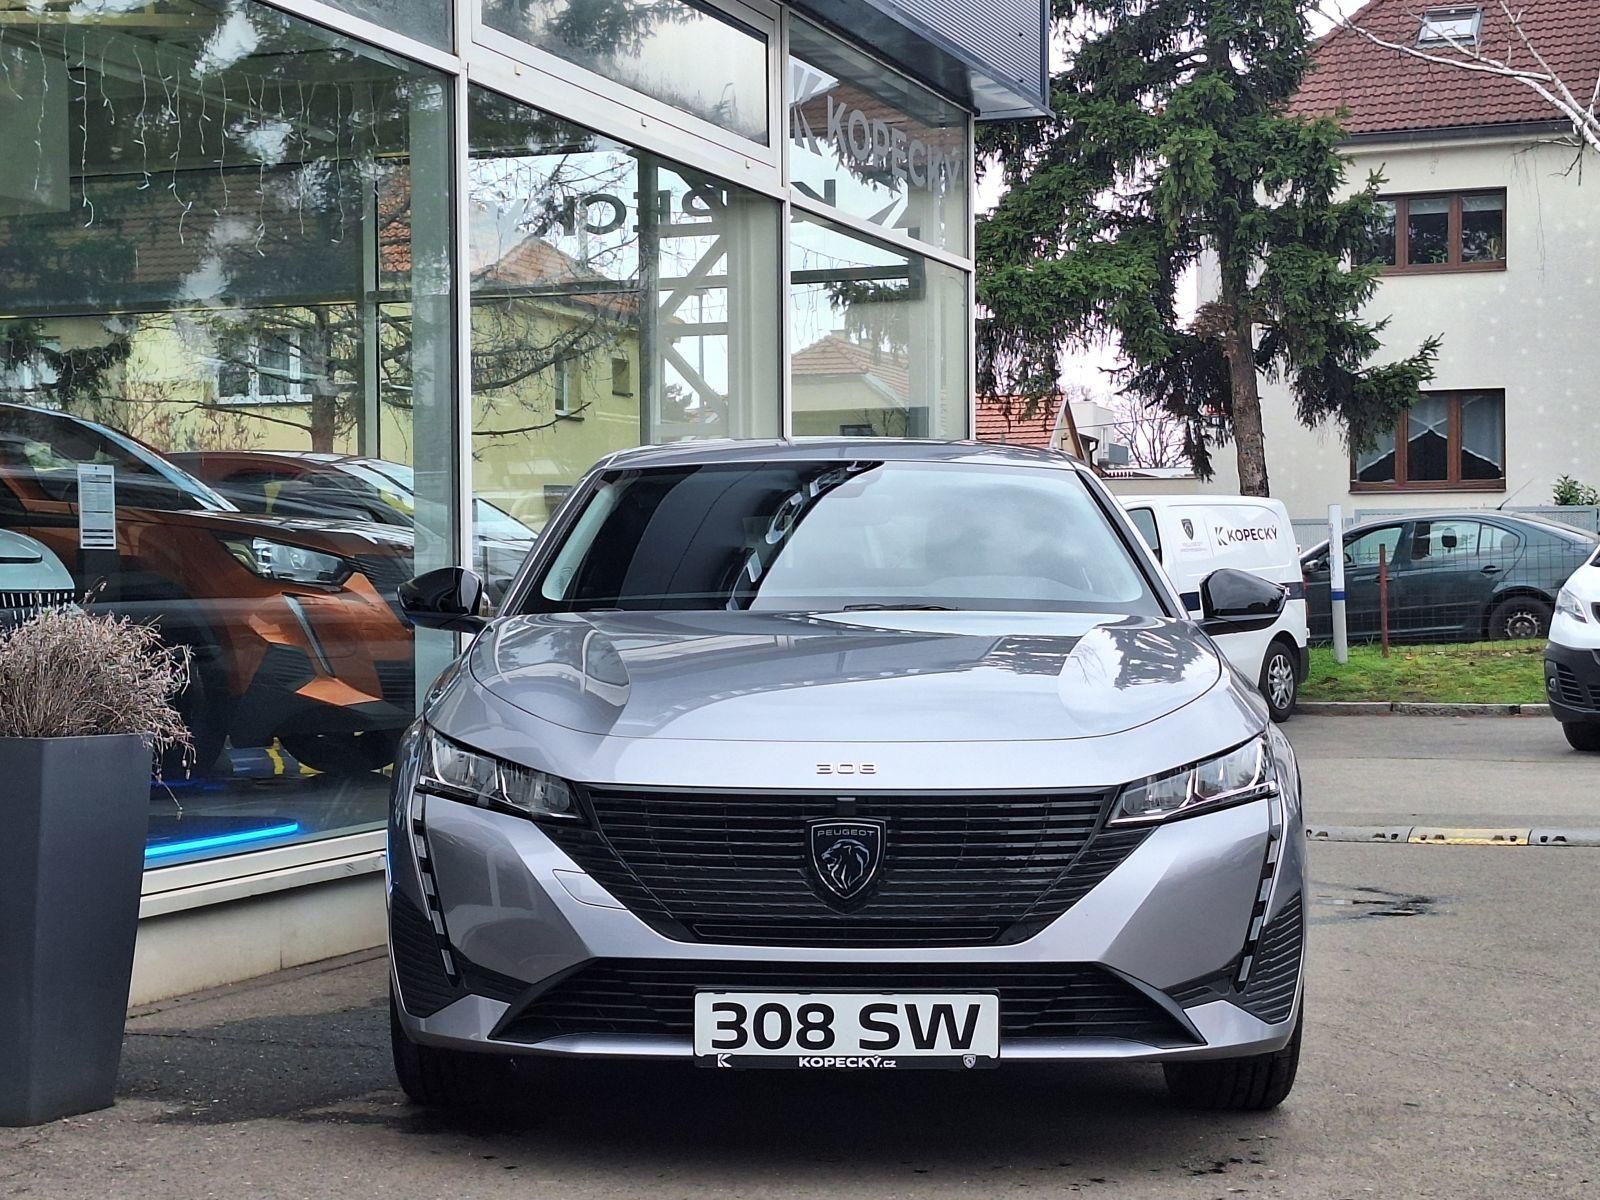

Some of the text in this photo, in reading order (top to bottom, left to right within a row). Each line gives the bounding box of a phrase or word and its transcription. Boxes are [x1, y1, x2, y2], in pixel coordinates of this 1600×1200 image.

[1227, 524, 1277, 541] KOPECKÝ
[815, 763, 877, 775] 308
[817, 828, 876, 838] PEUGEOT
[711, 1002, 981, 1050] 308 SW
